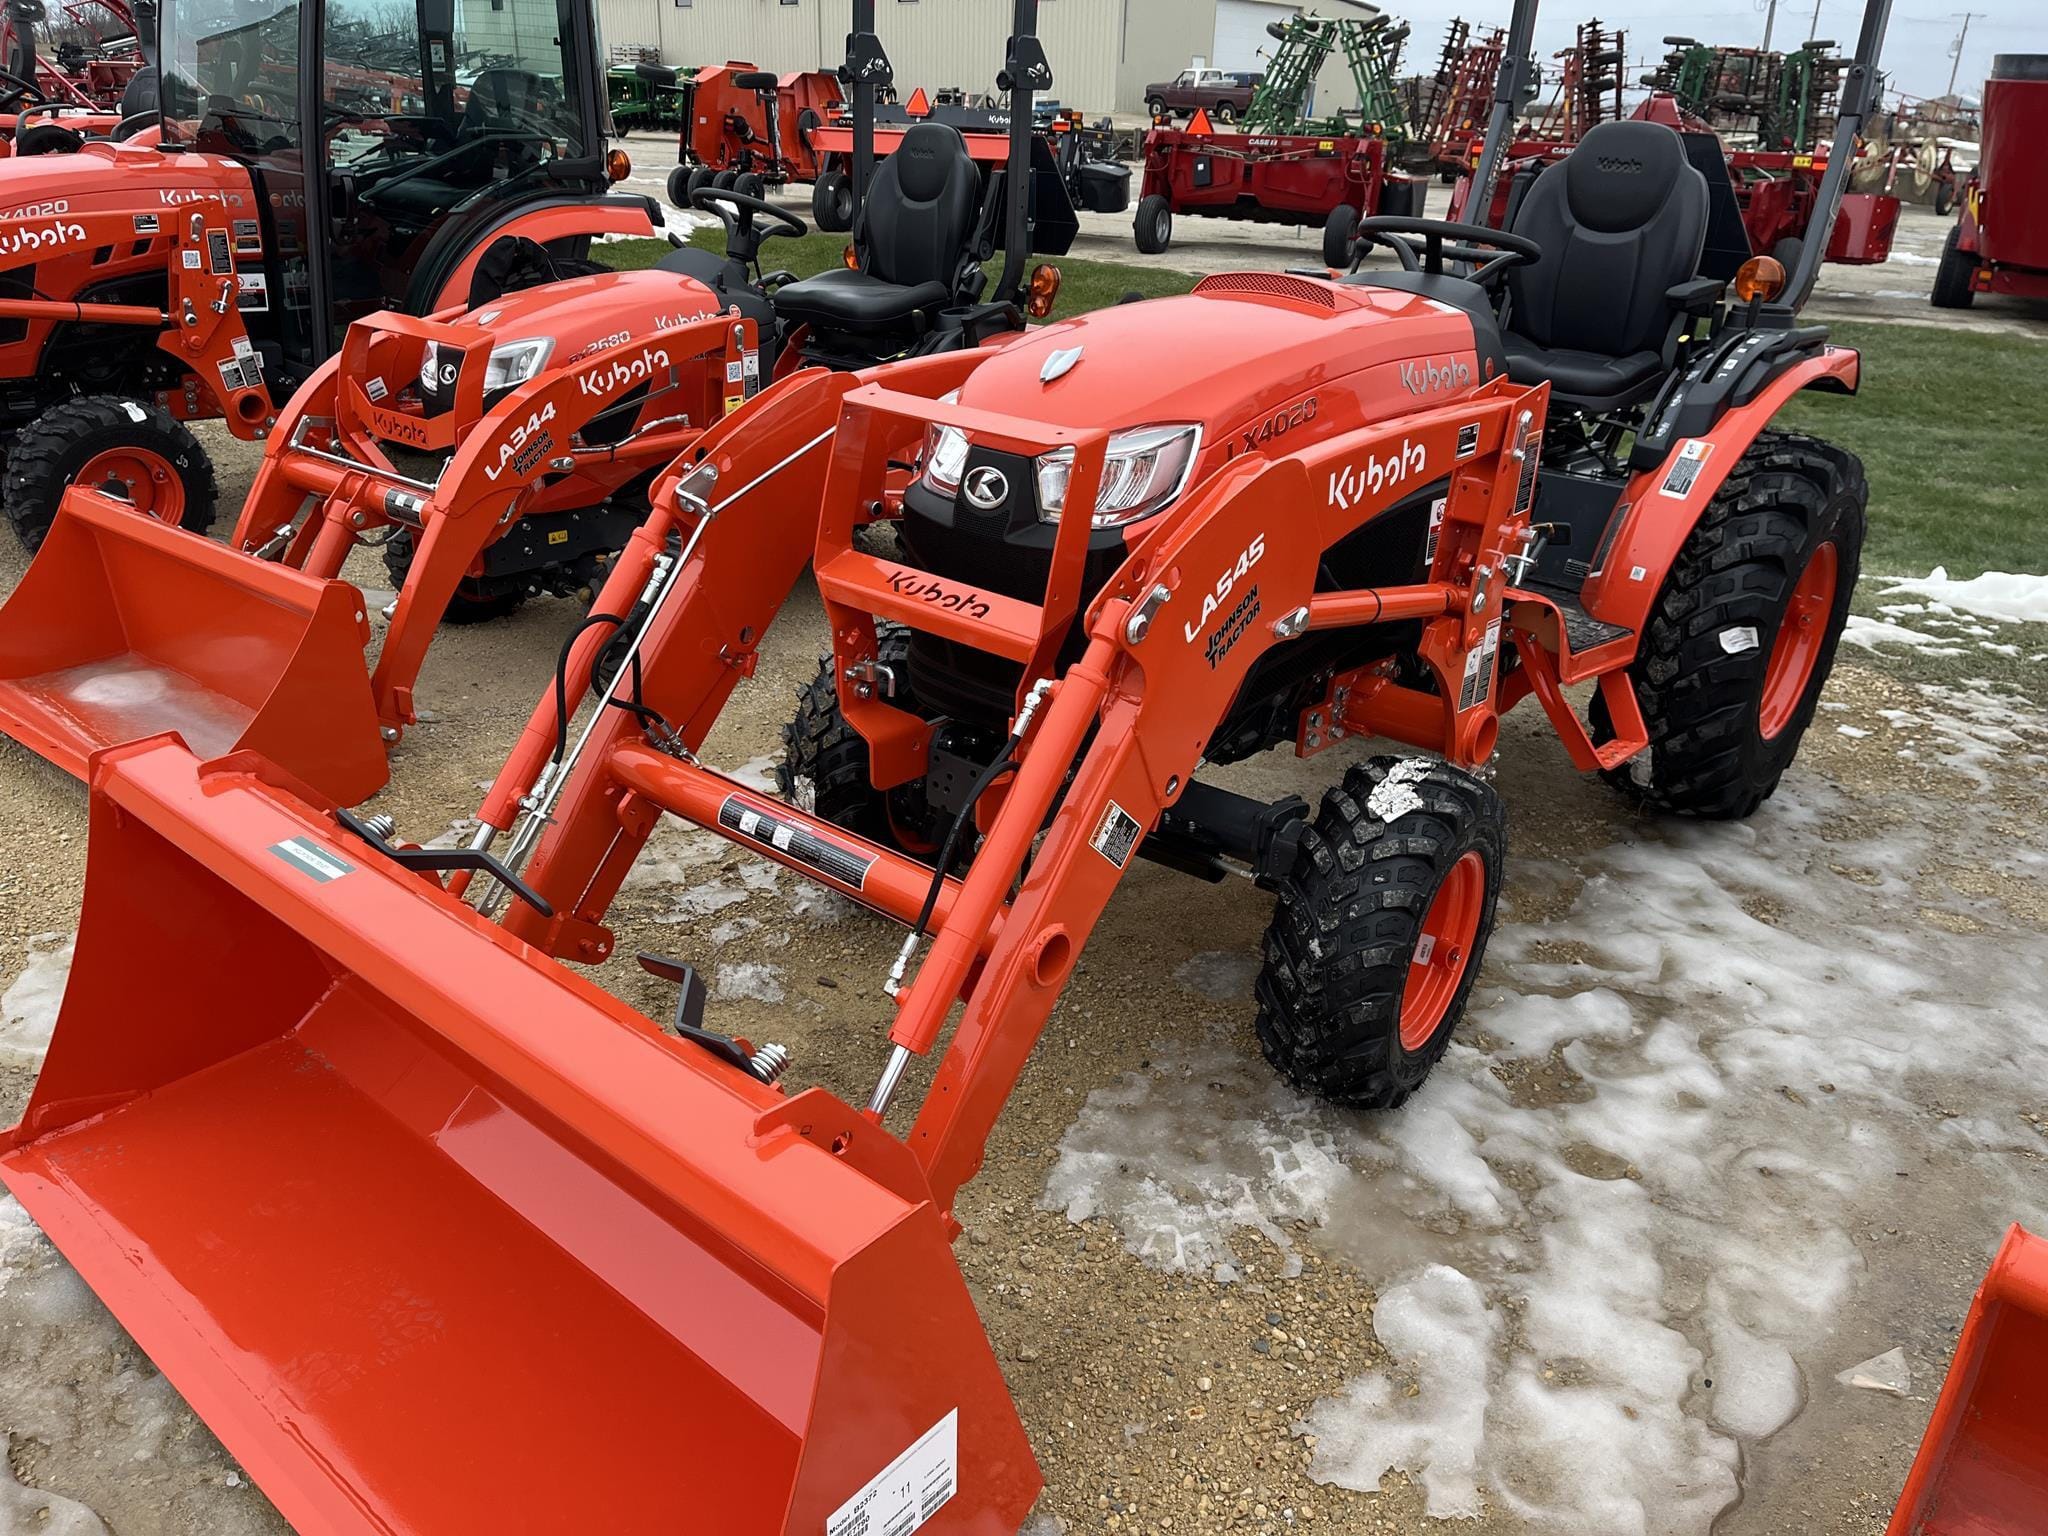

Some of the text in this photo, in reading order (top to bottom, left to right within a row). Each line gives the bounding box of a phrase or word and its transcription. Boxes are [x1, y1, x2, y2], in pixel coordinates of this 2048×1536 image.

[1597, 156, 1643, 173] Kubota
[579, 348, 670, 396] Kubota
[1399, 355, 1471, 396] Kubota
[372, 411, 427, 445] Kubota
[484, 401, 557, 481] LA344
[1328, 438, 1426, 510] Kubota
[886, 571, 991, 619] Kubota
[1184, 532, 1265, 643] LA545
[1204, 584, 1258, 658] JOHNSON
[1207, 601, 1261, 670] TRACTOR
[829, 1513, 850, 1535] Model
